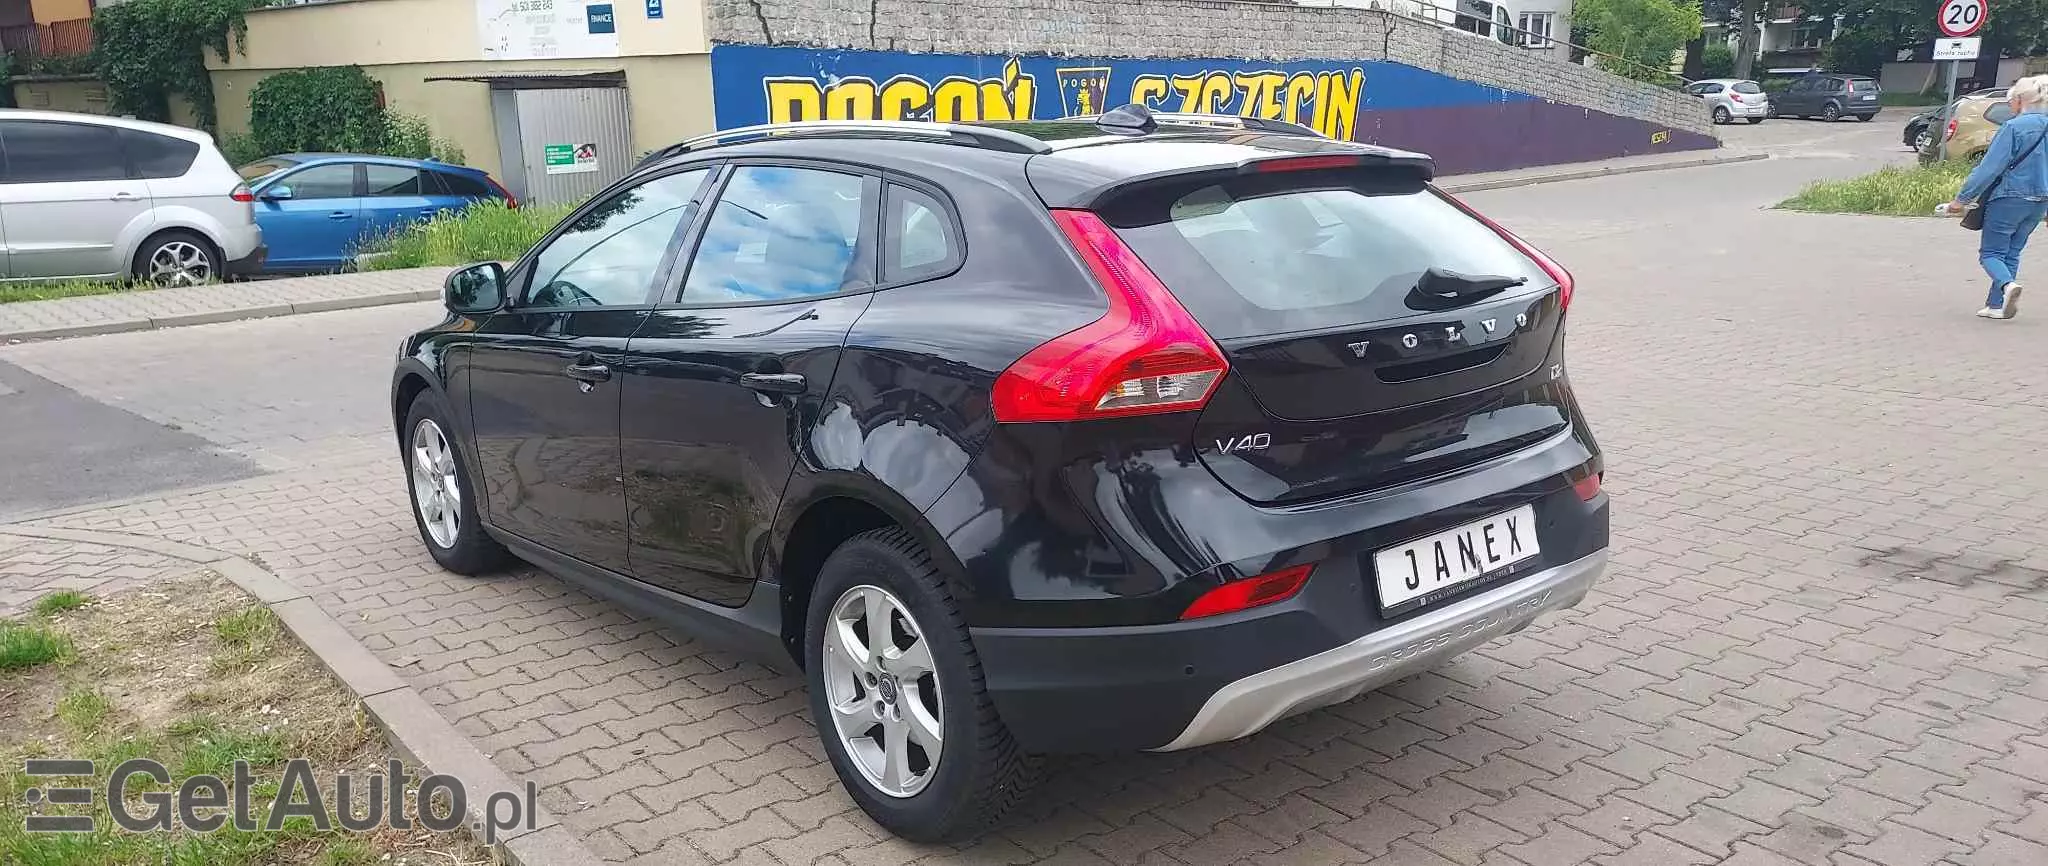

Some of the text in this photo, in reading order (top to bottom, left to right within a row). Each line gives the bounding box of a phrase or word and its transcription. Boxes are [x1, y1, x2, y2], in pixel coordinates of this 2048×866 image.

[1946, 4, 1979, 24] 20
[1348, 312, 1528, 357] VOLVO
[1215, 432, 1271, 455] V40
[1404, 515, 1522, 590] JANEX
[1369, 632, 1452, 671] CROSS
